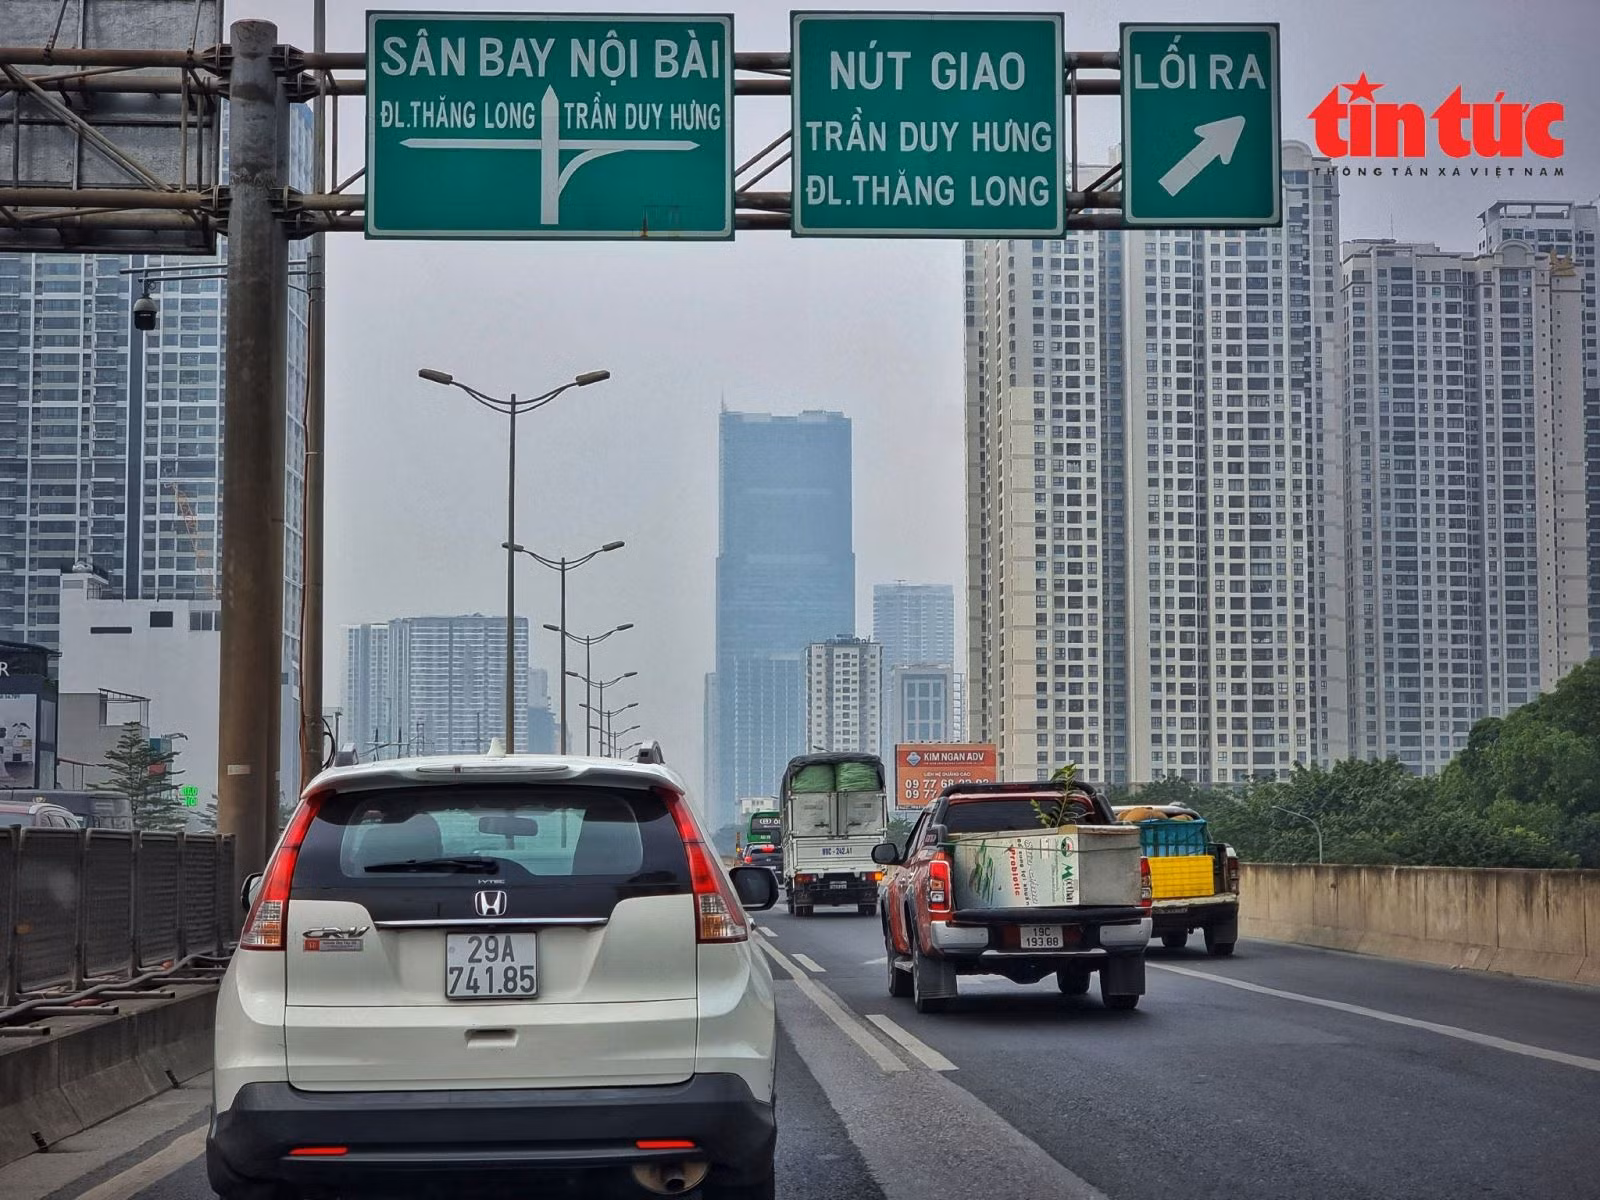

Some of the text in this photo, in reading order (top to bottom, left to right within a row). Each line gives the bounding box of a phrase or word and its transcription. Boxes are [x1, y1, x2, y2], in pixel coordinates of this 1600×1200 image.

[381, 28, 720, 86] SÂN BAY NỘI BÀI
[830, 39, 1026, 91] NÚT GIAO
[1134, 35, 1267, 90] LỐI RA
[380, 95, 536, 130] ĐL.THĂNG LONG
[564, 91, 721, 131] TRẦN DUY HƯNG
[805, 106, 1052, 152] TRẦN DUY HƯNG
[805, 169, 1049, 207] ĐL.THĂNG LONG
[924, 752, 940, 761] KIM
[966, 752, 984, 761] ADV
[905, 779, 919, 788] 09
[923, 779, 937, 788] 77
[905, 789, 937, 798] 09 77
[1010, 849, 1020, 896] Probiotic
[468, 935, 515, 963] 29A
[1033, 927, 1051, 936] 19C
[450, 966, 535, 994] 741.85
